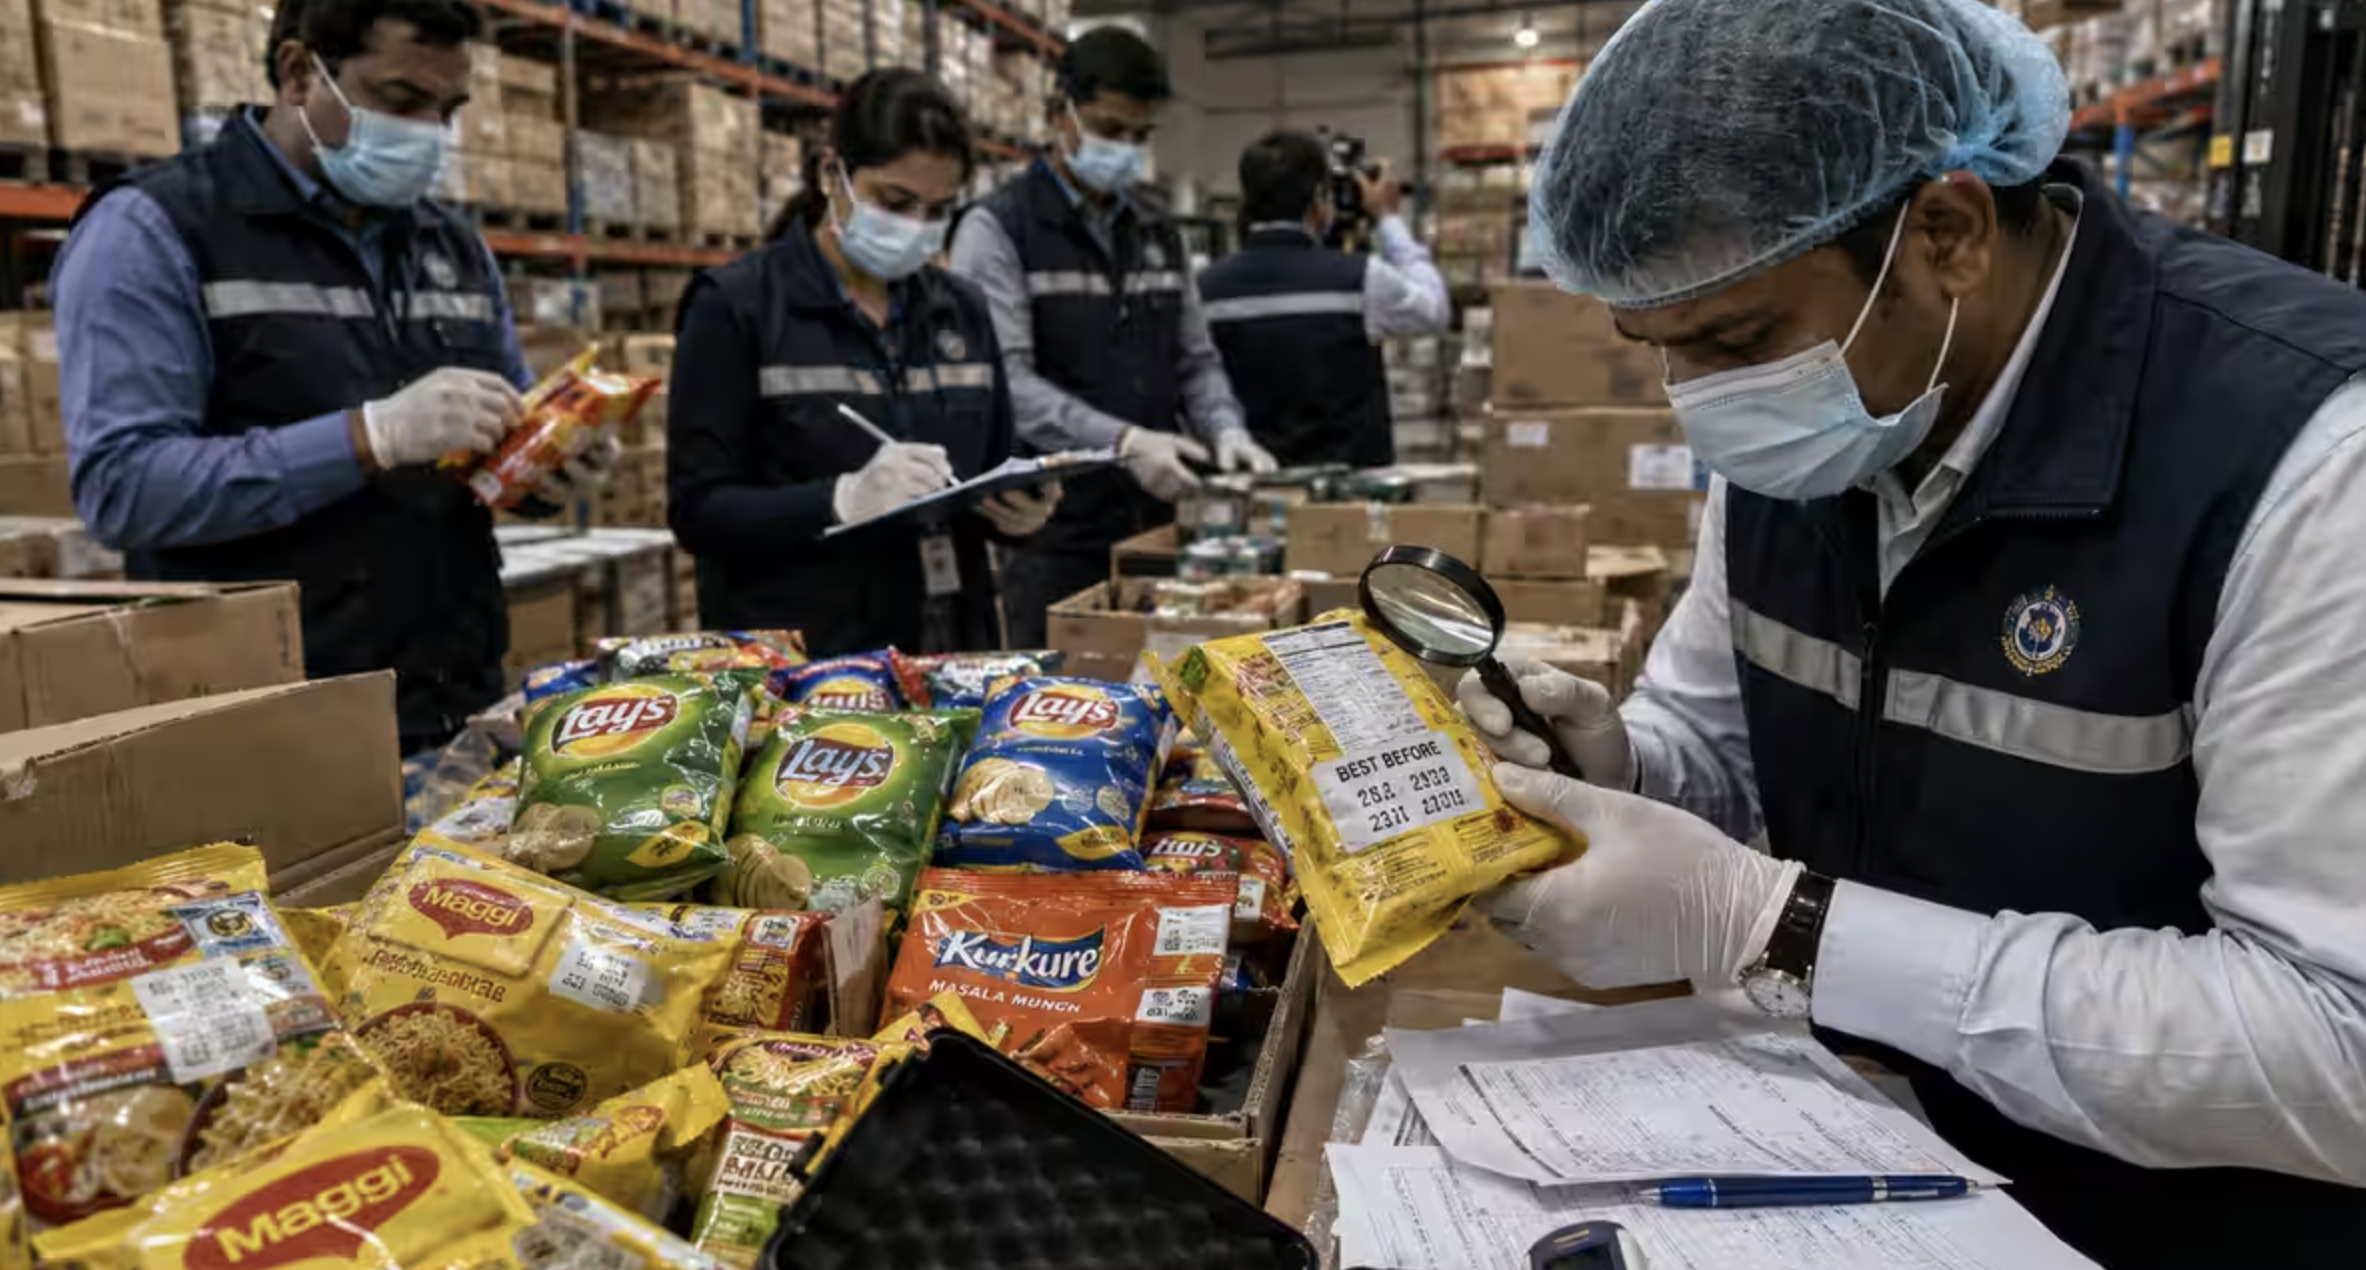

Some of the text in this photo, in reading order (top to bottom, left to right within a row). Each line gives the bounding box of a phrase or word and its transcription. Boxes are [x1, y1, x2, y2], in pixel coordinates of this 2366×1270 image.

[780, 738, 889, 786] Lay's
[1335, 740, 1442, 783] BEST BEFORE
[421, 885, 521, 927] Maggi
[940, 930, 1098, 979] Kurkure
[928, 978, 1082, 1014] MASALA MUNCH
[214, 1153, 414, 1263] Maggi
